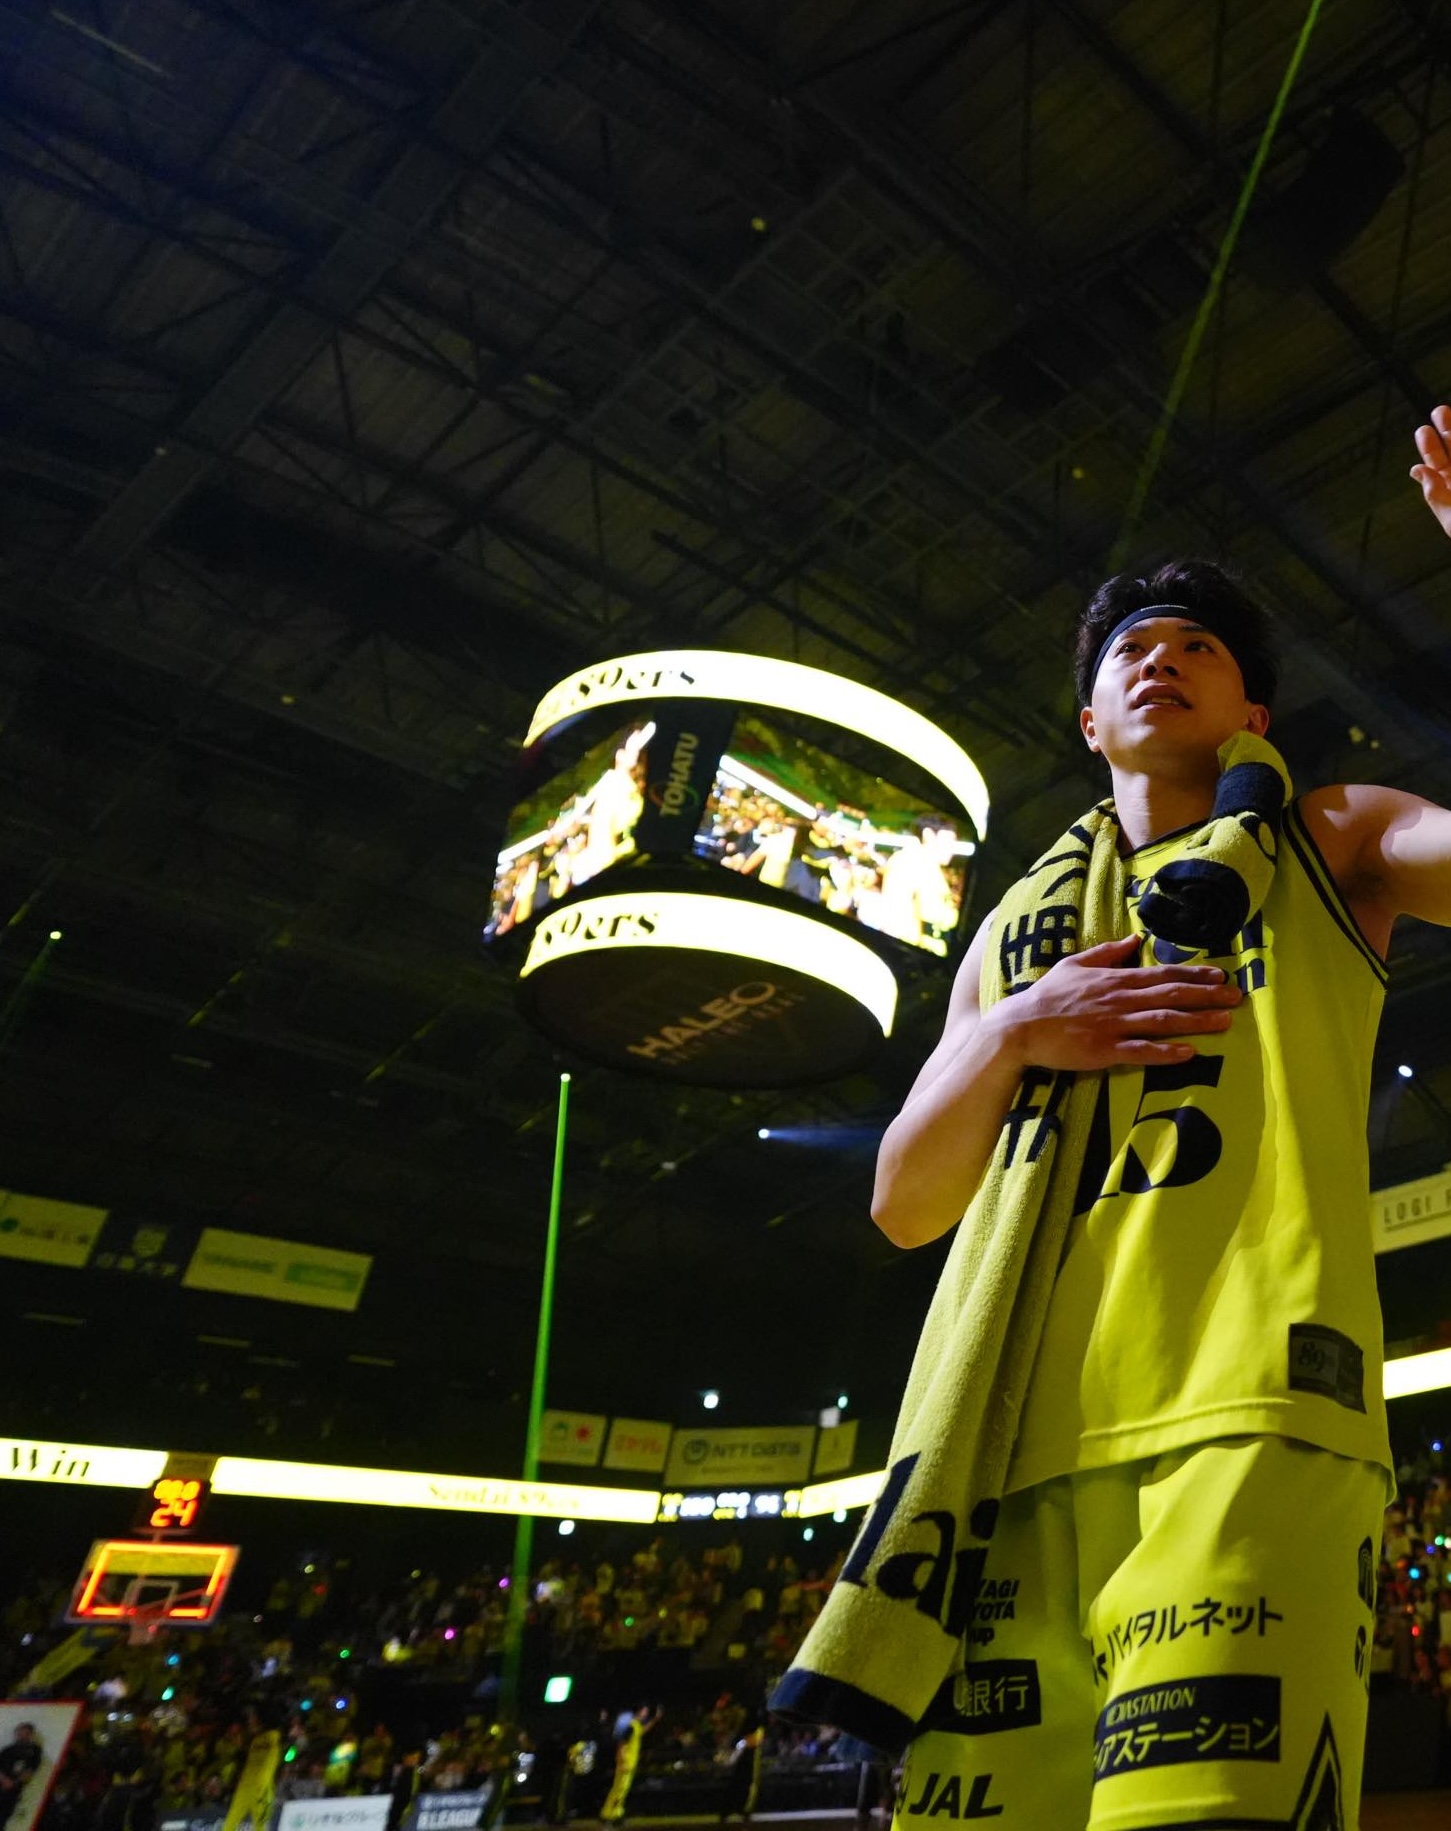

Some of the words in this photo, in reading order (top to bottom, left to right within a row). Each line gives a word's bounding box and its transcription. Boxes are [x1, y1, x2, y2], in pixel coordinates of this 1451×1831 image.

[658, 731, 701, 817] TOHATU
[626, 980, 777, 1058] HALEO
[1384, 1196, 1431, 1225] LOGI
[10, 1445, 91, 1480] Win
[150, 1499, 197, 1527] 24
[1107, 1597, 1283, 1669] バイタルネット
[909, 1773, 1004, 1819] JAL
